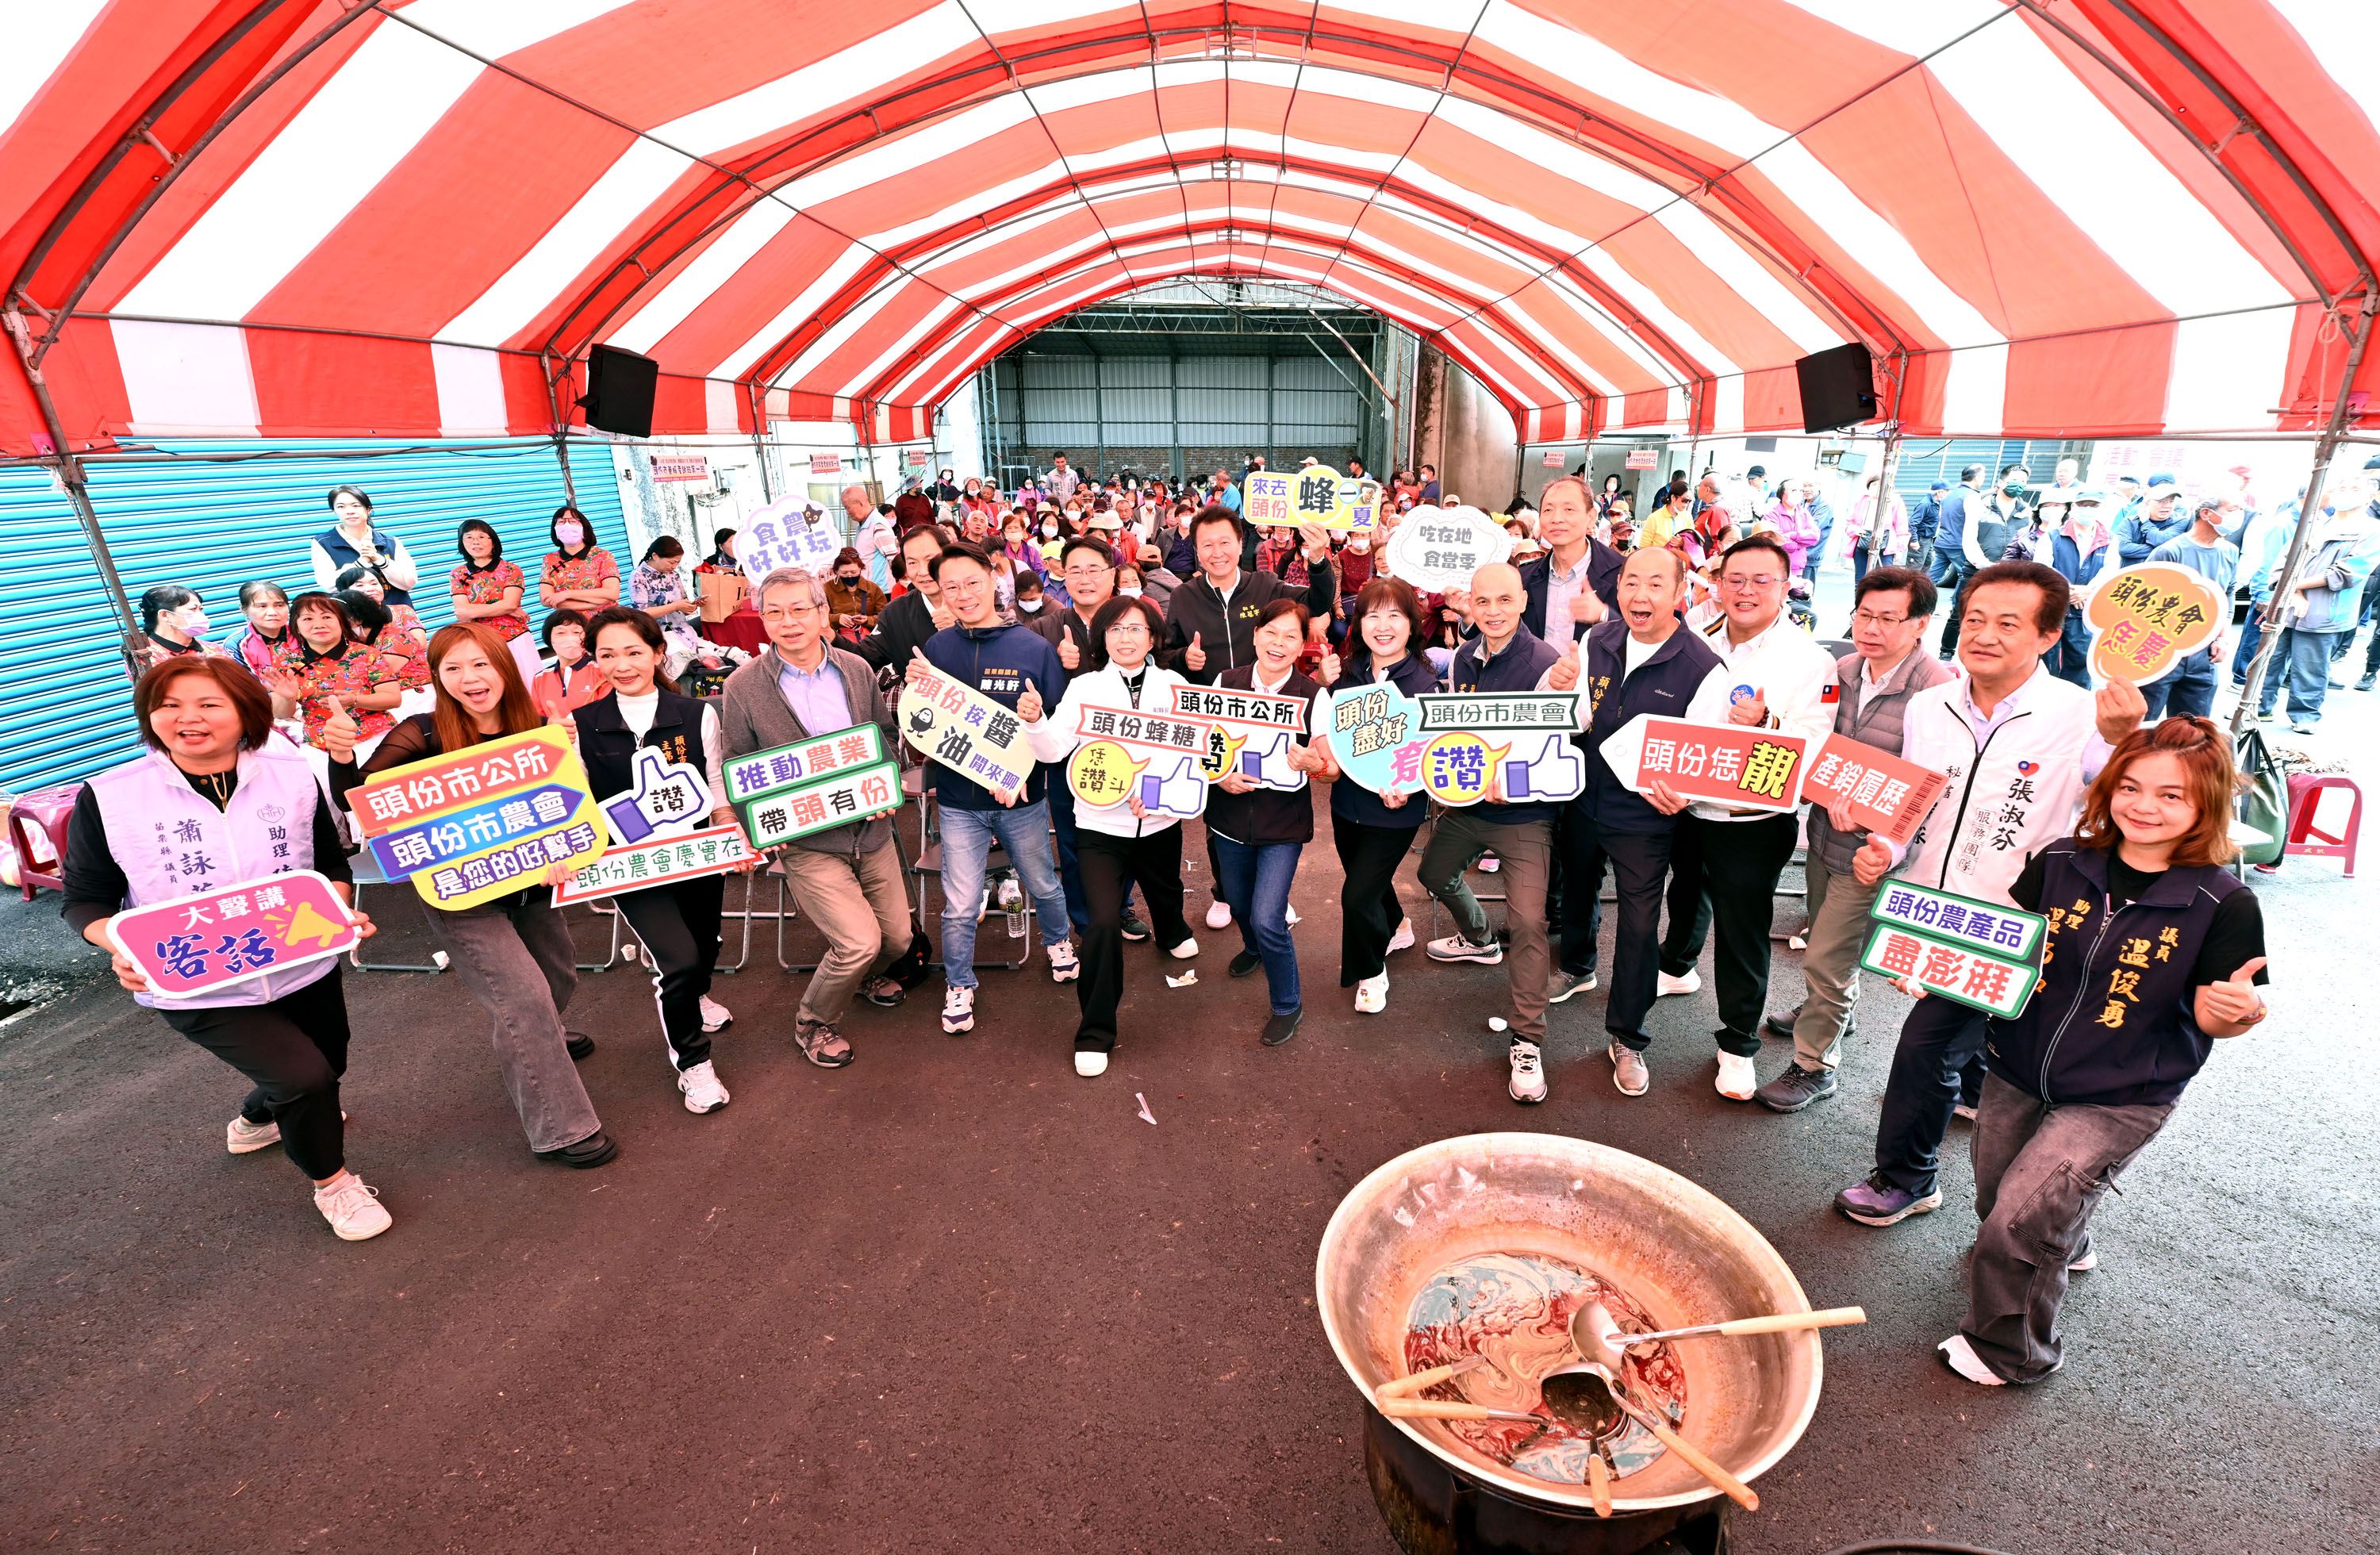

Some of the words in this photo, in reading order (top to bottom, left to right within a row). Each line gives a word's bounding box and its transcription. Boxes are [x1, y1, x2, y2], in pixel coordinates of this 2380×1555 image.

[1251, 497, 1288, 519] 頭份
[1252, 478, 1287, 496] 來去
[748, 530, 833, 573] 好好玩
[752, 511, 808, 547] 食農
[1419, 525, 1472, 544] 吃在地
[1423, 550, 1476, 570] 食當季
[2109, 576, 2205, 635] 頭份農會
[1091, 711, 1197, 748] 頭份蜂糖
[1180, 690, 1296, 725] 頭份市公所
[1335, 689, 1390, 733] 頭份
[1430, 701, 1568, 724] 頭份市農會
[1351, 712, 1408, 758] 盡好
[365, 744, 550, 821] 頭份市公所
[735, 735, 870, 794] 推動農業
[1430, 743, 1488, 792] 讚
[1641, 737, 1801, 801] 頭份恁靚
[1809, 751, 1912, 818] 產銷履歷
[649, 787, 686, 815] 讚
[758, 774, 890, 836] 帶頭有份
[1990, 778, 2036, 850] 張淑芬
[268, 825, 291, 858] 助理
[388, 789, 569, 869] 頭份市農會
[1957, 809, 1993, 873] 服務團隊
[431, 821, 597, 900] 是您的好幫手
[574, 835, 744, 889] 頭份農會慶實在
[178, 885, 287, 931] 大聲講
[1885, 889, 2025, 948] 頭份農產品
[2065, 898, 2092, 930] 助理
[156, 927, 276, 980] 客話
[2154, 926, 2179, 963] 議員
[1879, 932, 2013, 1005] 盡澎湃
